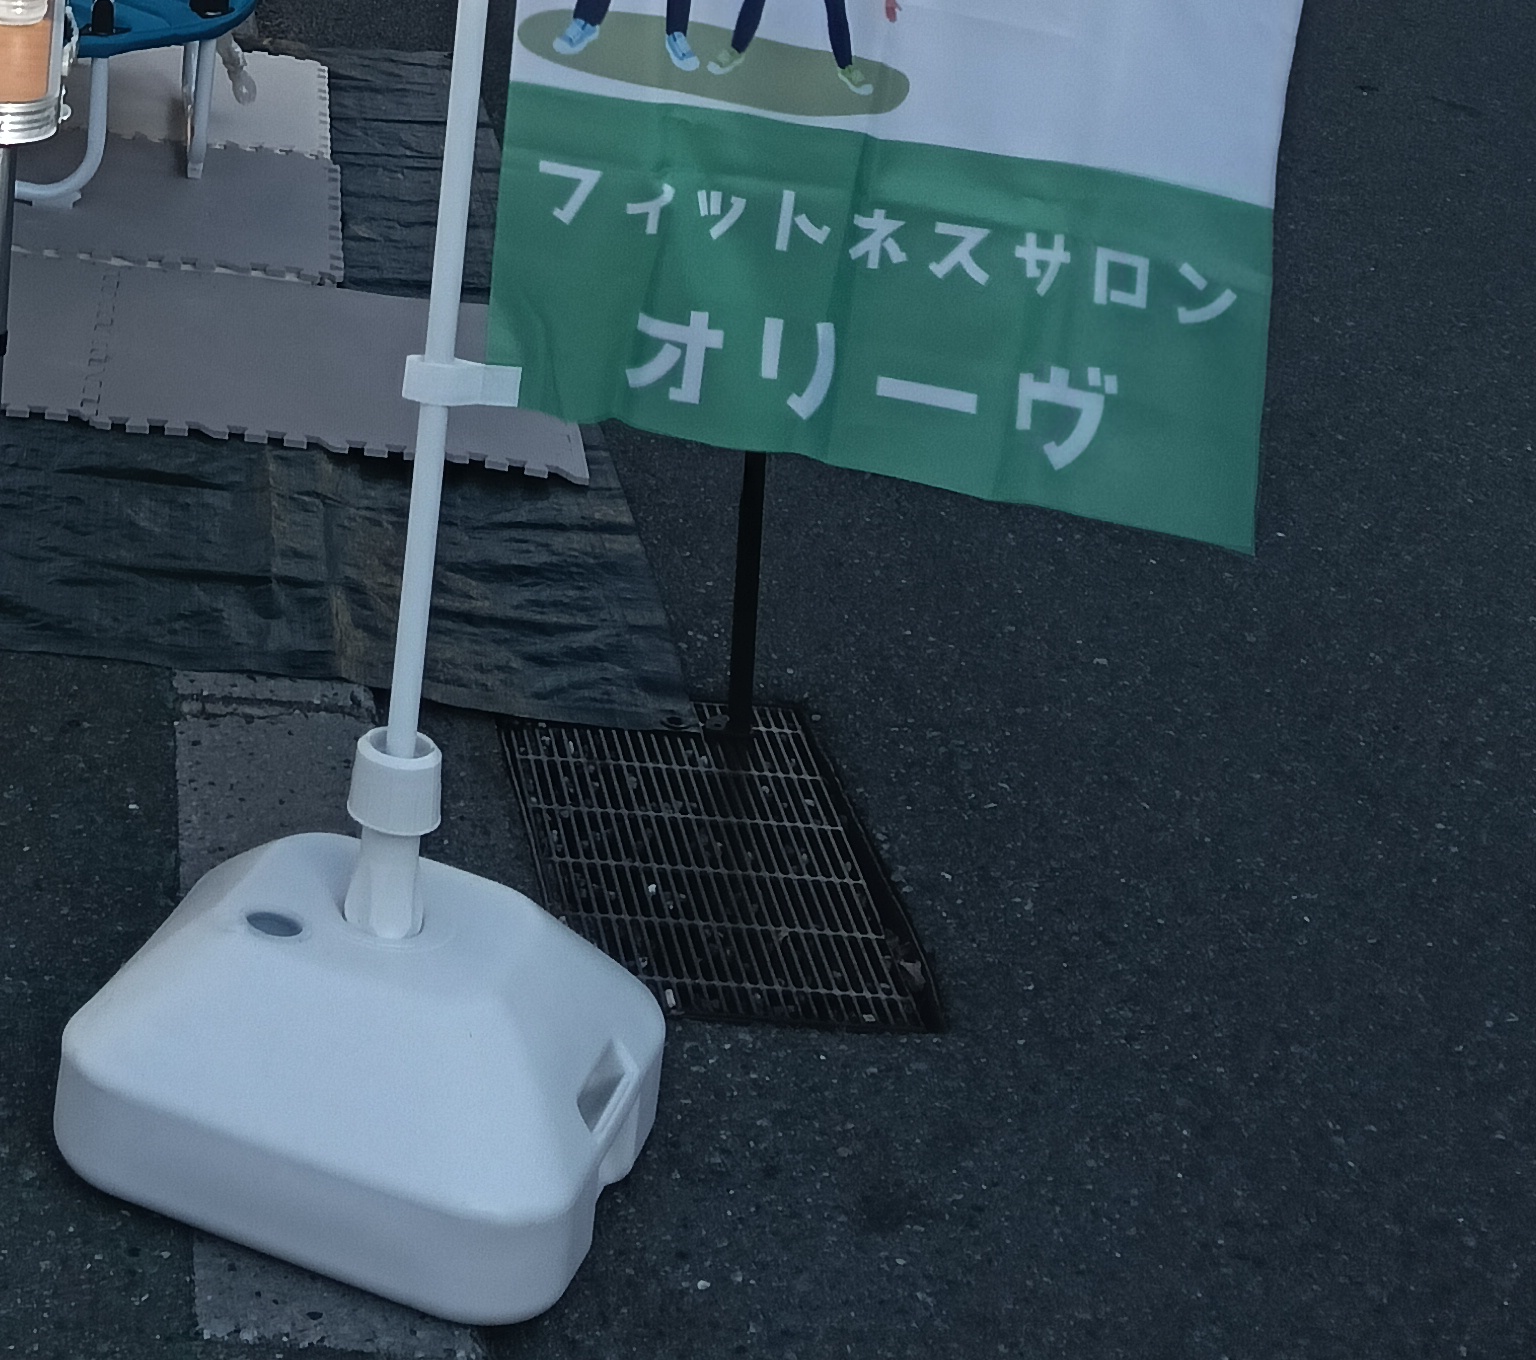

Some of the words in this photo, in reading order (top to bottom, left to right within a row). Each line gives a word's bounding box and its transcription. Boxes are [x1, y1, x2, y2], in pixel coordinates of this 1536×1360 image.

[539, 159, 1237, 325] フィットネスサロン
[626, 310, 1118, 471] オリーヴ
